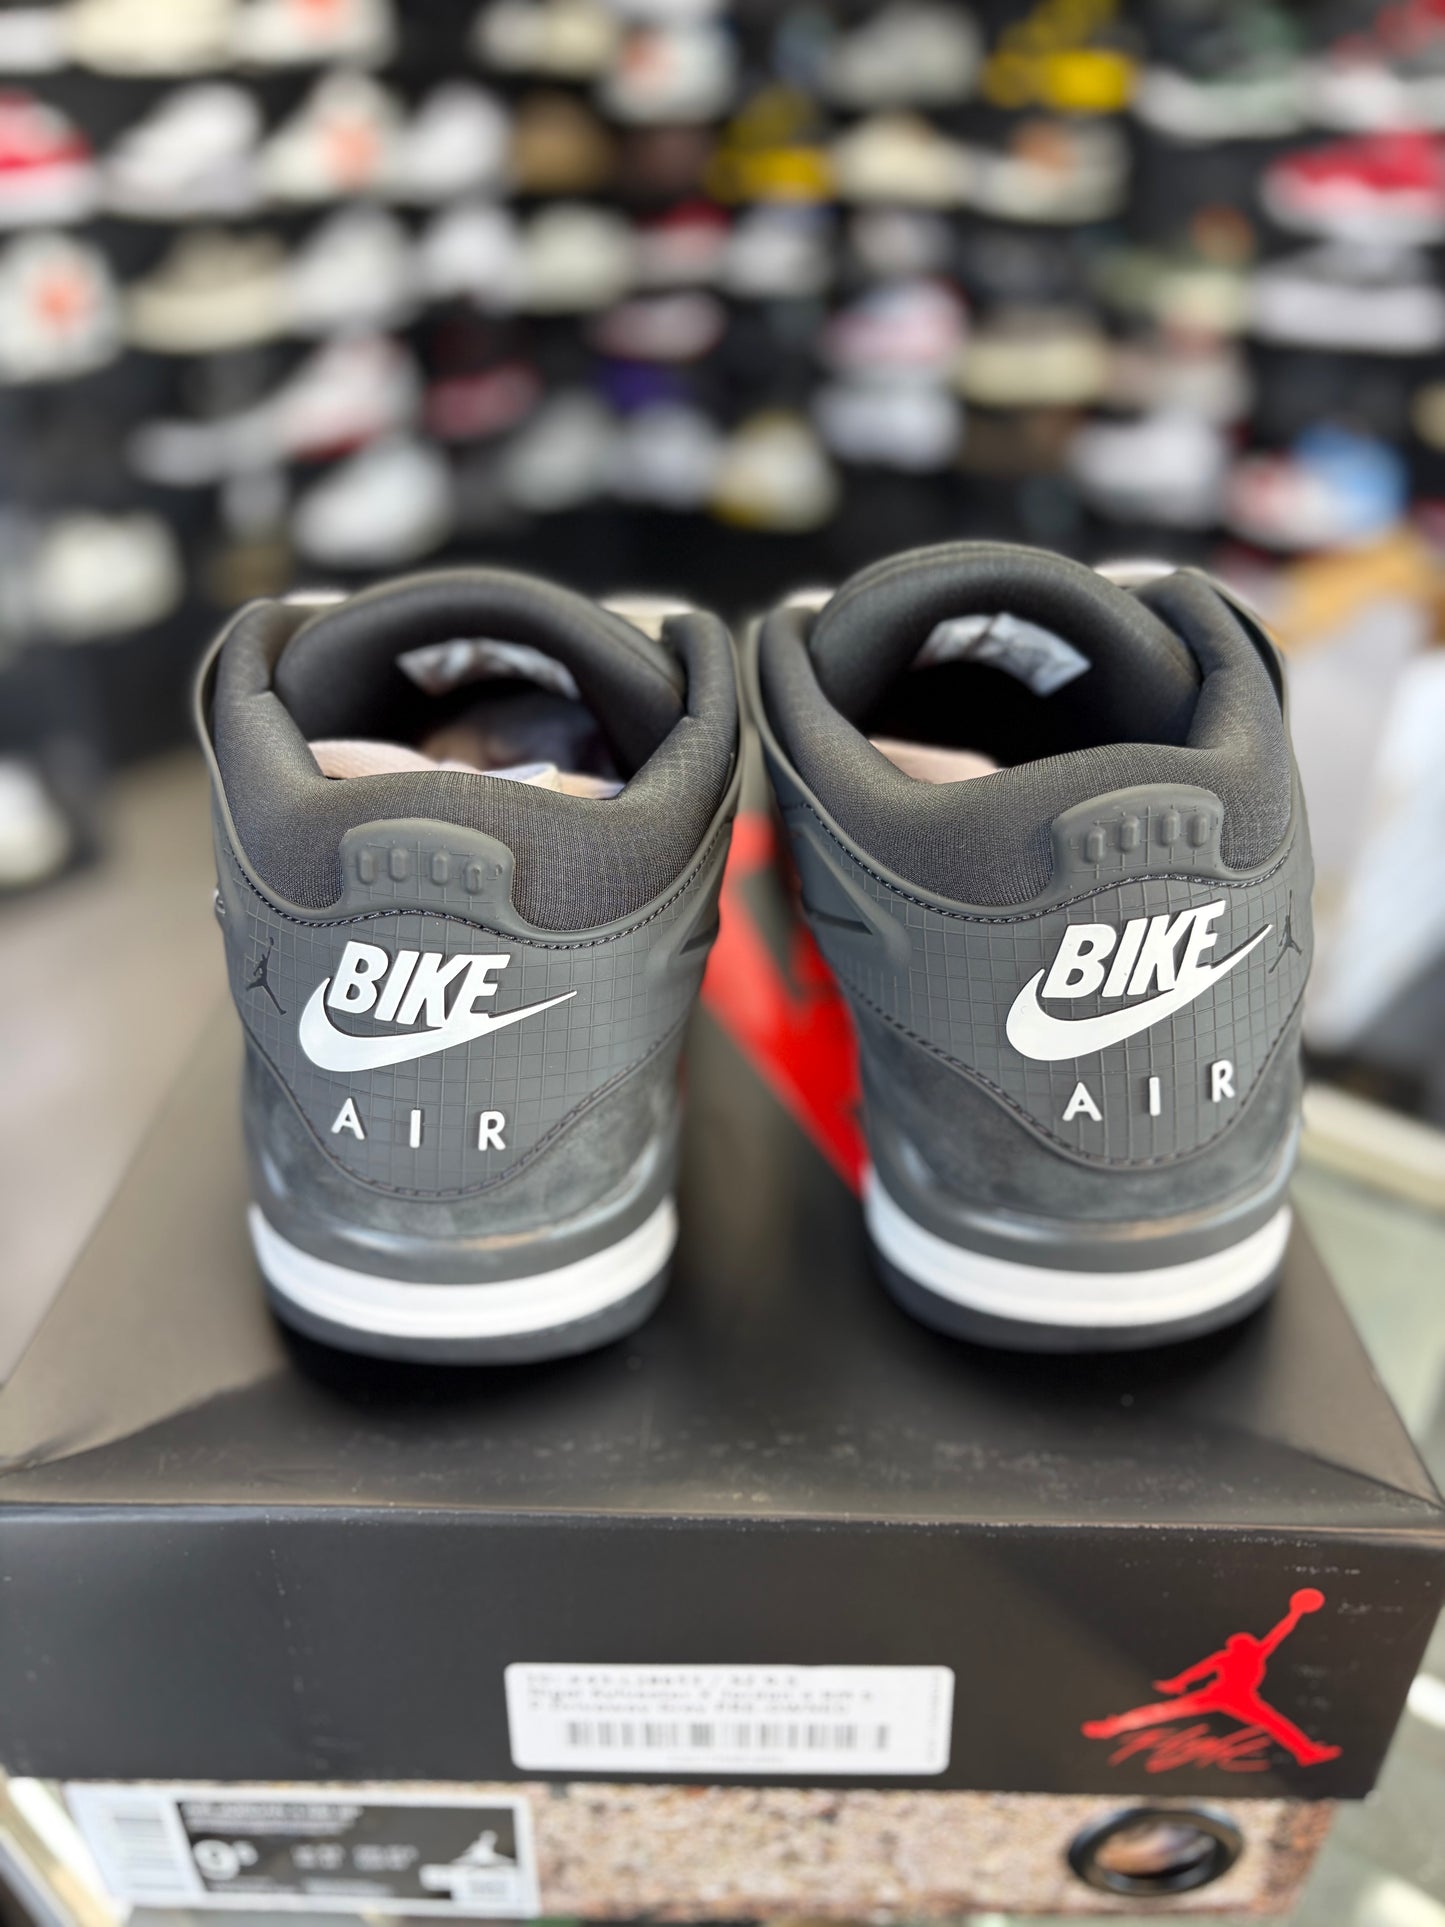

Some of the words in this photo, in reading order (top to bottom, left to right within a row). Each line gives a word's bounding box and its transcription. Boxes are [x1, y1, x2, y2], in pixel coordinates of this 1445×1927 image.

[327, 941, 510, 1028] BIKE
[1041, 900, 1226, 998] BIKE
[331, 1097, 506, 1151] AIR
[1062, 1060, 1235, 1121] AIR
